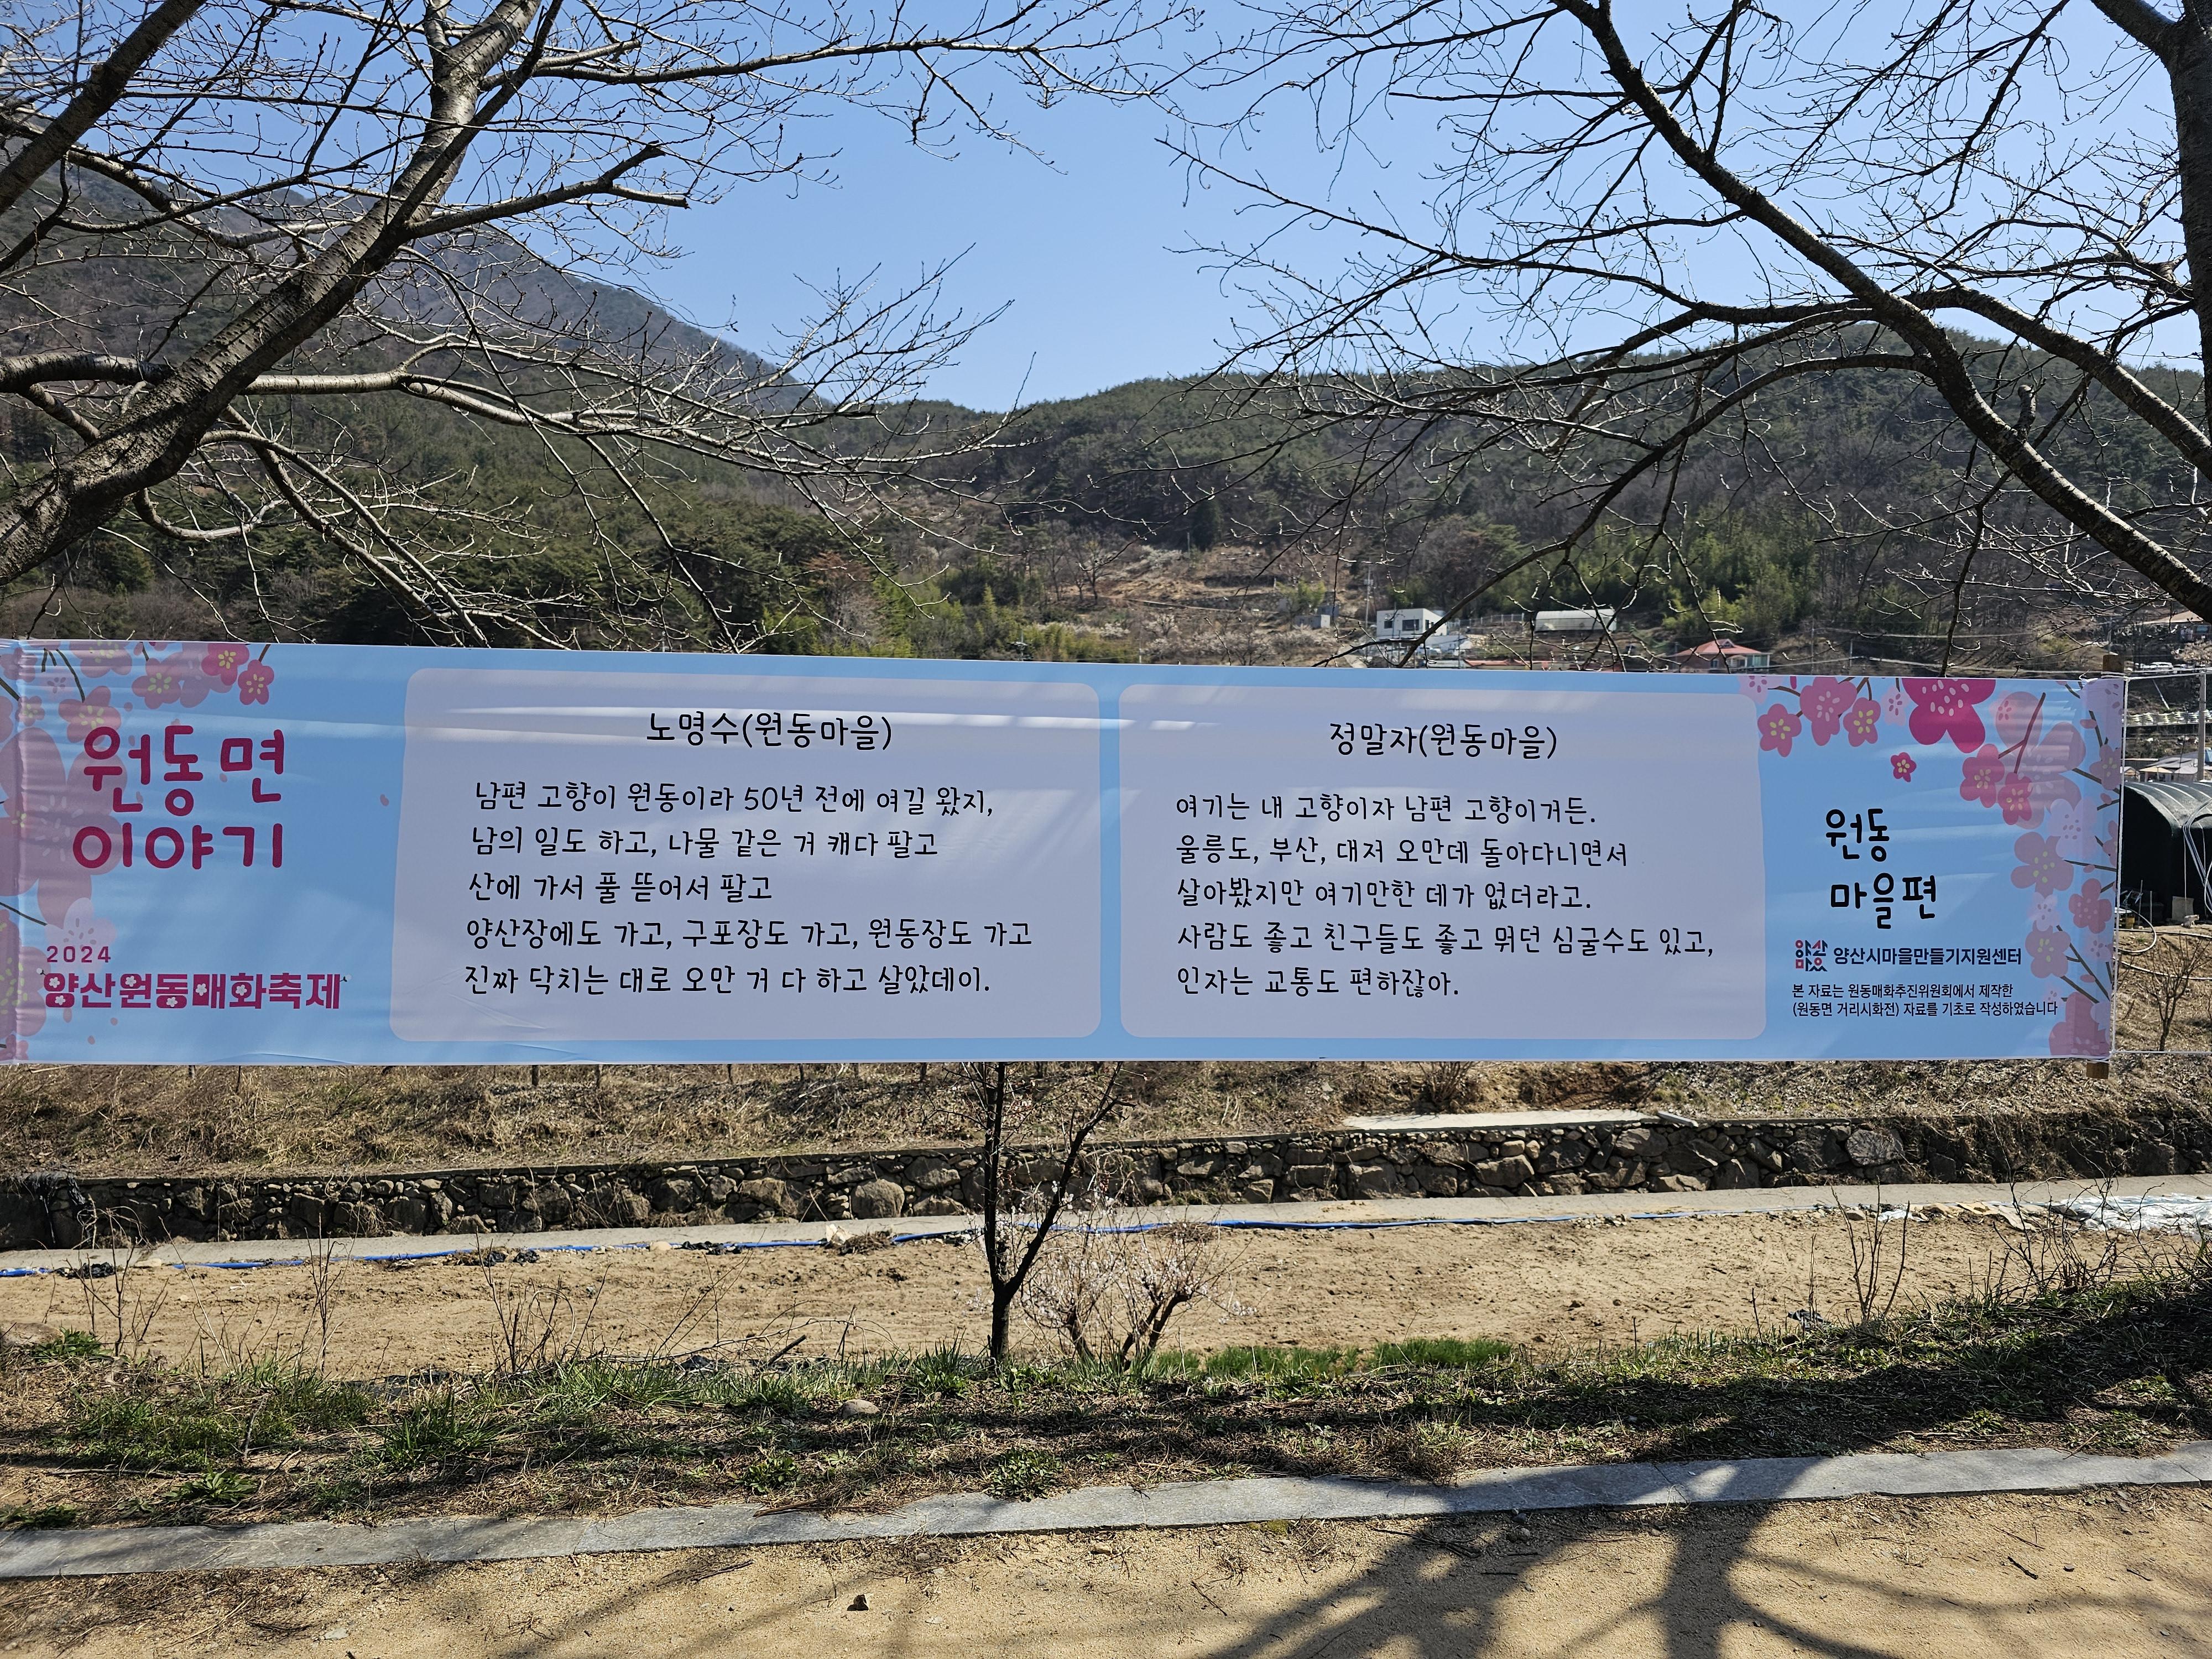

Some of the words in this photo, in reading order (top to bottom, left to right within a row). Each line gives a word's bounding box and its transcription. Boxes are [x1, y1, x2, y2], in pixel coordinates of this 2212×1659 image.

[646, 711, 891, 750] 노명수(원동마을)
[1330, 722, 1557, 760] 정말자(원동마을)
[84, 725, 284, 816] 원동면
[476, 781, 525, 810] 남편
[538, 781, 615, 812] 고향이
[627, 782, 734, 813] 원동이라
[744, 784, 803, 812] 50년
[815, 785, 864, 813] 전에
[877, 786, 924, 815] 여길
[936, 786, 993, 817] 왔지,
[1176, 792, 1250, 820] 여기는
[1262, 796, 1282, 819] 내
[1295, 793, 1395, 822] 고향이자
[1406, 795, 1451, 822] 남편
[1464, 795, 1595, 825] 고향이거든.
[72, 823, 283, 869] 이야기
[472, 826, 522, 855] 남의
[535, 826, 586, 857] 일도
[598, 830, 656, 858] 하고,
[669, 828, 719, 859] 나물
[732, 828, 781, 858] 같은
[794, 831, 814, 856] 거
[827, 832, 879, 857] 캐다
[887, 830, 938, 859] 팔고
[1176, 834, 1259, 864] 울릉도,
[1269, 836, 1326, 865] 부산,
[1337, 839, 1383, 863] 대저
[1396, 838, 1468, 864] 오만데
[1480, 838, 1626, 868] 돌아다니면서
[1825, 808, 1890, 862] 원동
[469, 872, 520, 901] 산에
[534, 874, 582, 901] 가서
[595, 872, 620, 904] 풀
[630, 872, 708, 902] 뜯어서
[720, 873, 772, 903] 팔고
[1177, 877, 1304, 908] 살아봤지만
[1316, 879, 1415, 907] 여기만한
[1426, 883, 1475, 908] 데가
[1485, 881, 1590, 910] 없더라고.
[1830, 872, 1936, 930] 마을편
[467, 917, 601, 950] 양산장에도
[614, 921, 672, 950] 가고,
[682, 919, 789, 950] 구포장도
[801, 921, 858, 950] 가고,
[868, 918, 972, 950] 원동장도
[984, 922, 1032, 947] 가고
[1177, 922, 1253, 951] 사람도
[1264, 921, 1313, 953] 좋고
[1324, 922, 1424, 954] 친구들도
[1434, 924, 1483, 955] 좋고
[1494, 925, 1540, 953] 뭐던
[1553, 926, 1649, 957] 심굴수도
[1660, 927, 1713, 957] 있고,
[46, 946, 111, 963] 2024
[1833, 947, 2021, 966] 양산시마을만들기지원센터
[44, 973, 341, 1009] 양산원동매화축제
[465, 965, 519, 994] 진짜
[530, 964, 609, 995] 닥치는
[620, 966, 671, 993] 대로
[682, 965, 735, 994] 오만
[747, 967, 768, 993] 거
[782, 968, 806, 993] 다
[816, 967, 867, 993] 하고
[878, 964, 989, 995] 살았데이.
[1177, 966, 1253, 995] 인자는
[1265, 967, 1339, 997] 교통도
[1349, 967, 1458, 998] 편하잖아.
[1792, 984, 1804, 998] 본
[1808, 983, 1844, 998] 자료는
[1848, 984, 1975, 999] 원동매화추진위원회에서
[1978, 983, 2013, 998] 제작한
[1793, 1002, 1833, 1017] (원동면
[1837, 1002, 1900, 1017] 거리시화전)
[1903, 1002, 1938, 1017] 자료를
[1942, 1002, 1976, 1016] 기초로
[1979, 1001, 2058, 1016] 작성하였습니다
